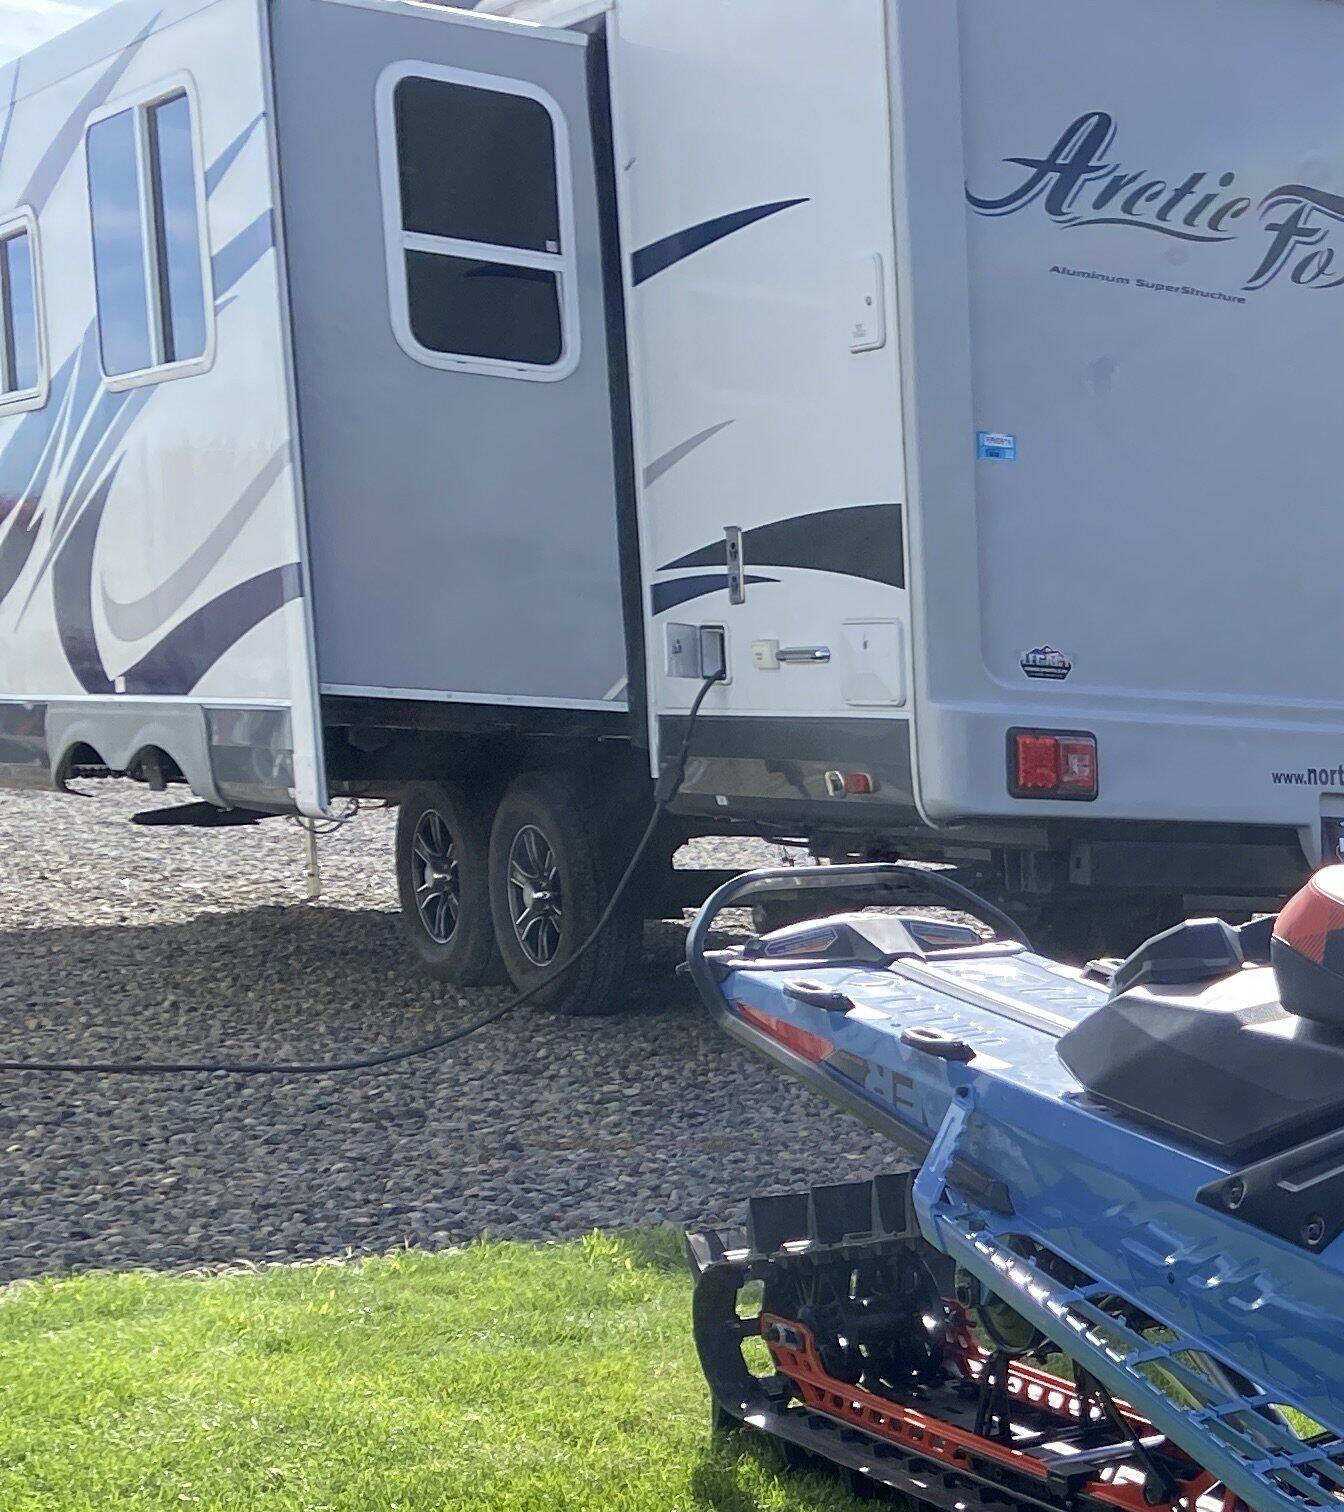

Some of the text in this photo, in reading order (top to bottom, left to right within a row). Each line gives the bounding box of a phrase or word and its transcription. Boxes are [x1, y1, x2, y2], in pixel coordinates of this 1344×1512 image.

[964, 111, 1251, 233] Arctic
[1049, 265, 1247, 304] Aluminum SuperStructure
